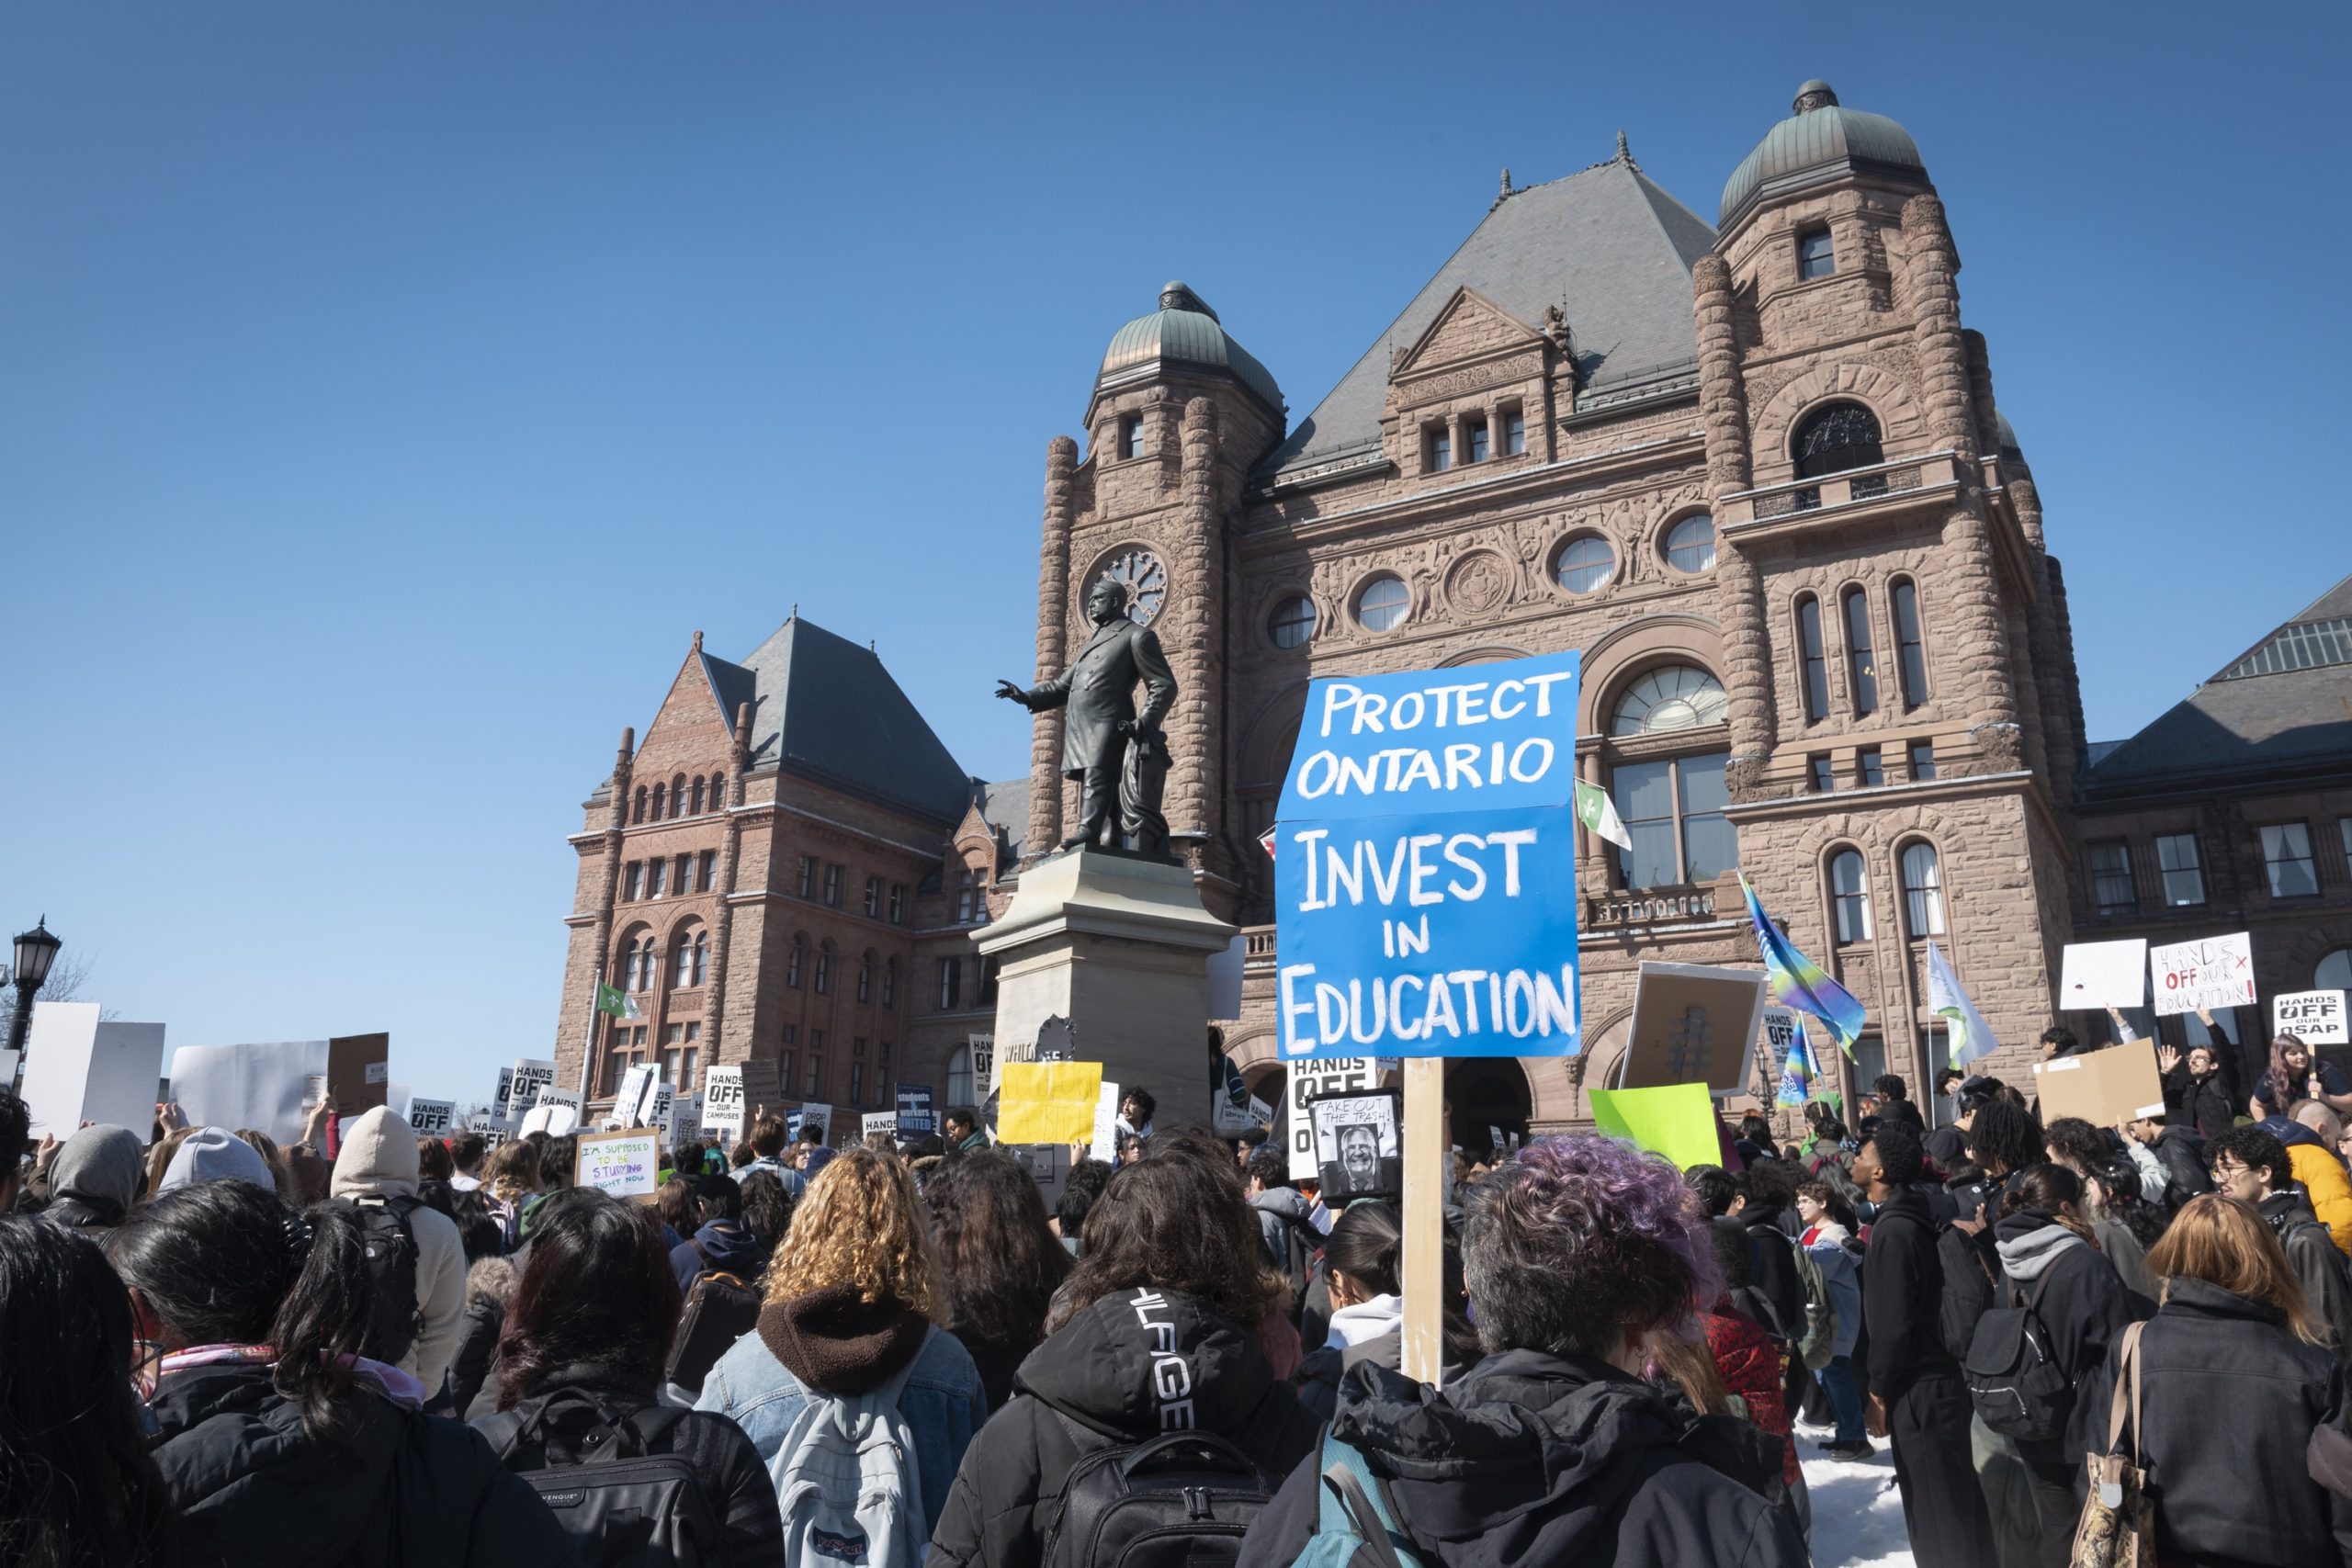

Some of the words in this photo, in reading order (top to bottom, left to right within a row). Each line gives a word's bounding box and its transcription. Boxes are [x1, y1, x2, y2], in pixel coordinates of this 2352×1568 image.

[1320, 671, 1572, 737] PROTECT
[1296, 738, 1555, 799] ONTARIO
[1295, 829, 1538, 912] INVEST
[1383, 913, 1430, 958] IN
[2155, 940, 2234, 974] HANDS
[2165, 968, 2197, 990] OFF
[2199, 964, 2234, 985] OUR
[2279, 996, 2337, 1007] HANDS
[1281, 963, 1576, 1055] EDUCATION
[2280, 1004, 2337, 1020] OFF
[1765, 1014, 1792, 1026] HANDS
[2280, 1024, 2339, 1034] OSAP
[974, 1041, 993, 1052] HAN
[516, 1066, 553, 1079] HANDS
[1295, 1057, 1366, 1076] HANDS
[711, 1075, 743, 1085] HANDS
[709, 1086, 743, 1102] OFF
[898, 1093, 930, 1102] students
[413, 1104, 449, 1114] HANDS
[899, 1108, 930, 1117] workers
[1317, 1100, 1353, 1112] TAKE
[1353, 1099, 1384, 1112] OUT
[412, 1113, 448, 1129] OFF
[678, 1118, 697, 1127] DROP
[1323, 1112, 1349, 1123] THE
[1352, 1109, 1391, 1123] TRASH!
[899, 1116, 932, 1131] UNITED
[677, 1127, 696, 1137] FEES
[582, 1146, 600, 1156] I'M
[605, 1143, 649, 1155] SUPPOSED
[617, 1155, 629, 1164] BE
[593, 1164, 642, 1178] STUDYING
[593, 1179, 621, 1190] RIGHT
[626, 1175, 645, 1183] NOW
